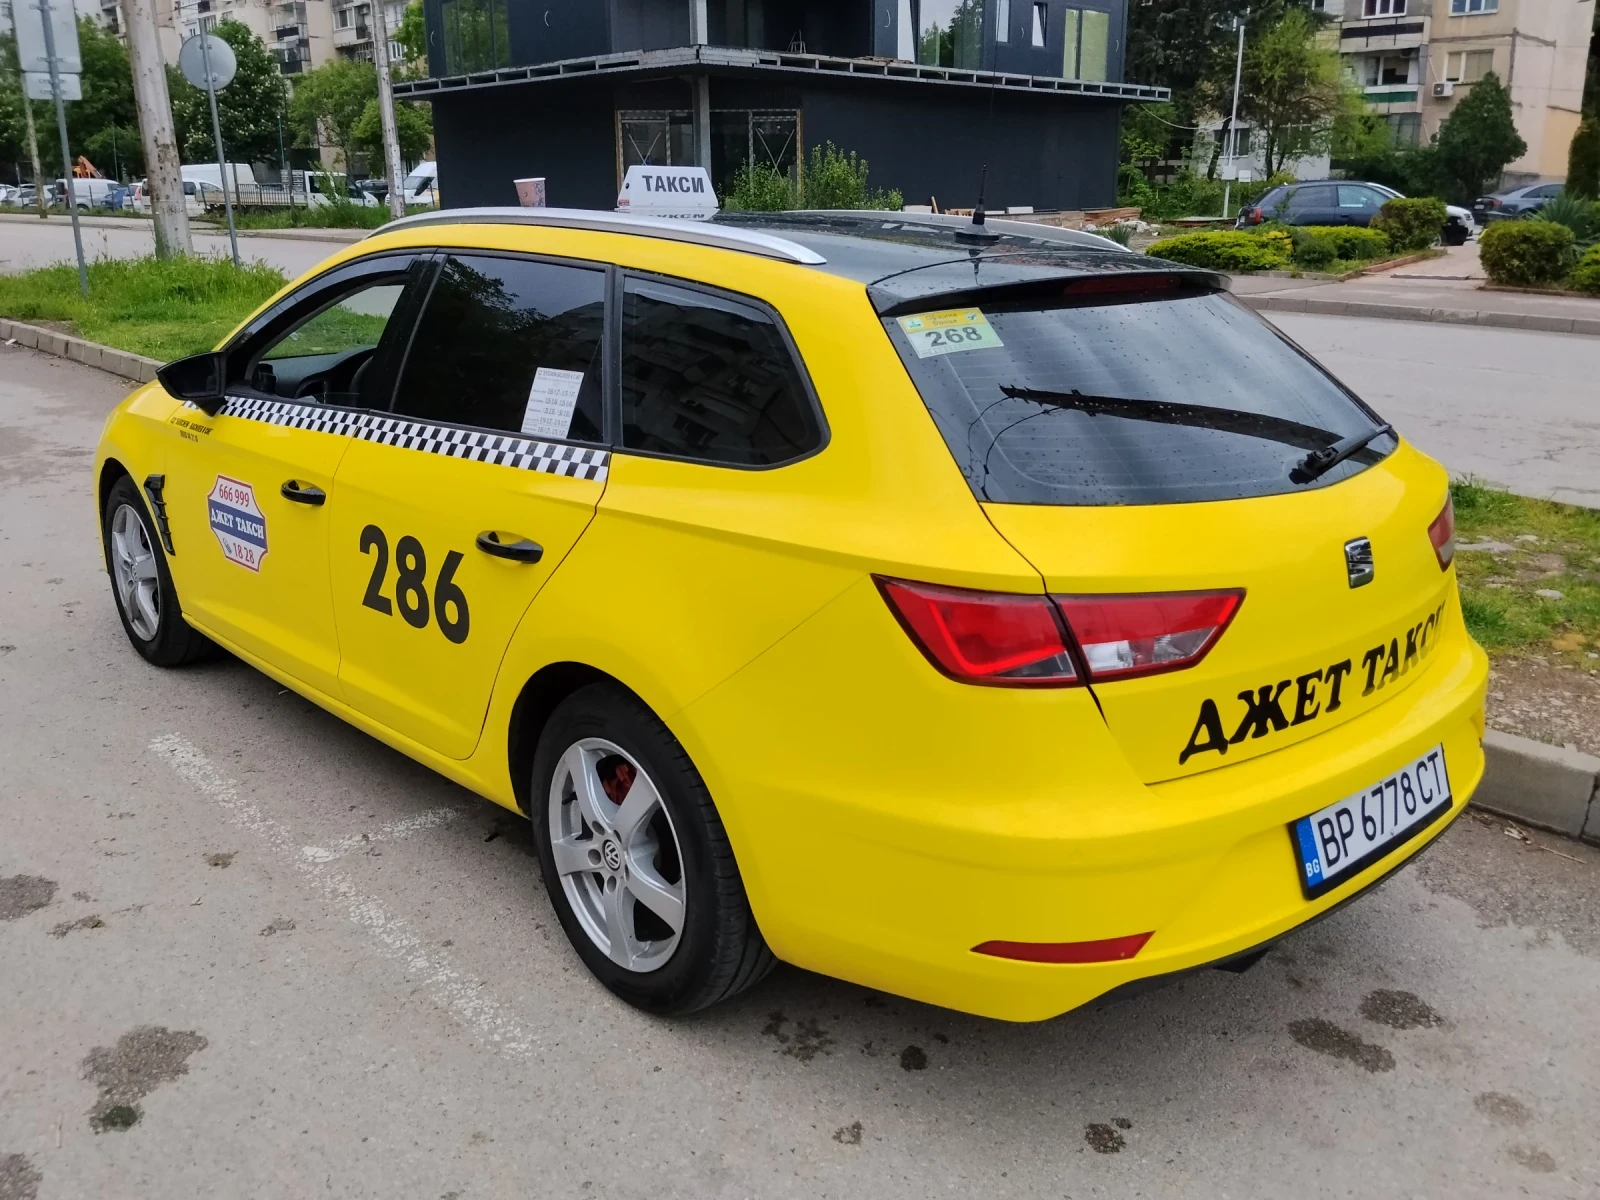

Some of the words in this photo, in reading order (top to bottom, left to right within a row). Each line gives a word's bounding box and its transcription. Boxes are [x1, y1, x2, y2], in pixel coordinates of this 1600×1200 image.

[642, 175, 705, 193] ТАКСИ
[925, 326, 982, 347] 268
[219, 484, 233, 502] 666
[234, 489, 250, 508] 999
[211, 507, 234, 528] ДЖЕТ
[235, 516, 265, 540] ТАКСИ
[360, 524, 470, 644] 286
[1178, 658, 1352, 765] ДЖЕТ
[1361, 772, 1417, 842] 6778
[1305, 859, 1320, 878] BG
